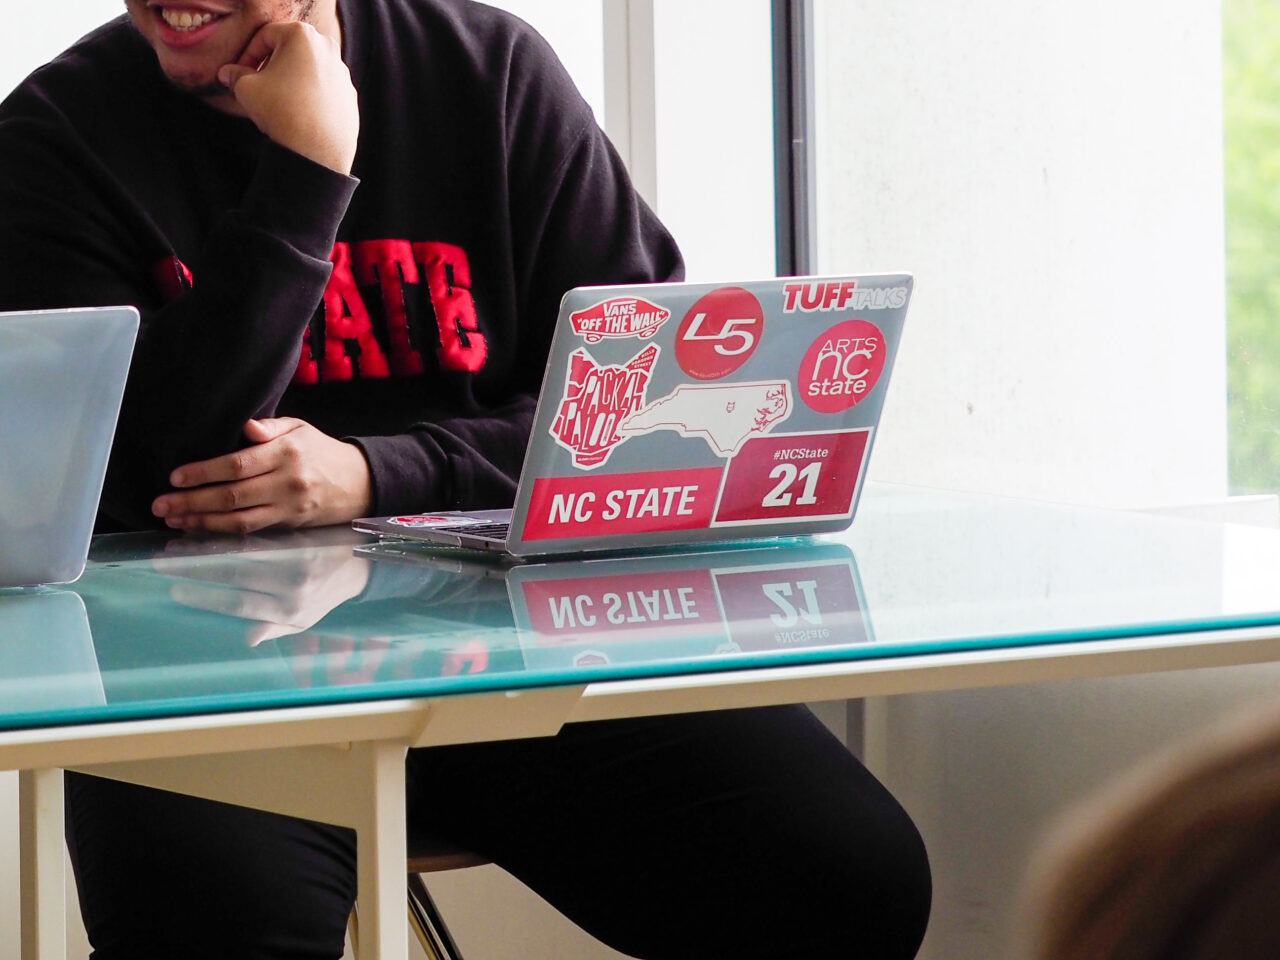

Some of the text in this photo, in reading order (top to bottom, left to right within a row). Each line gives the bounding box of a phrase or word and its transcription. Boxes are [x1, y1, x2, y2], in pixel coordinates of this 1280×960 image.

[603, 300, 637, 317] VANS
[784, 282, 855, 311] TUFF
[604, 314, 628, 333] THE
[683, 313, 756, 356] L5
[820, 337, 878, 354] ARTS
[812, 350, 872, 381] nc
[807, 378, 867, 397] state
[773, 448, 829, 460] #NCState
[761, 461, 823, 508] 21
[548, 485, 699, 525] NC STATE
